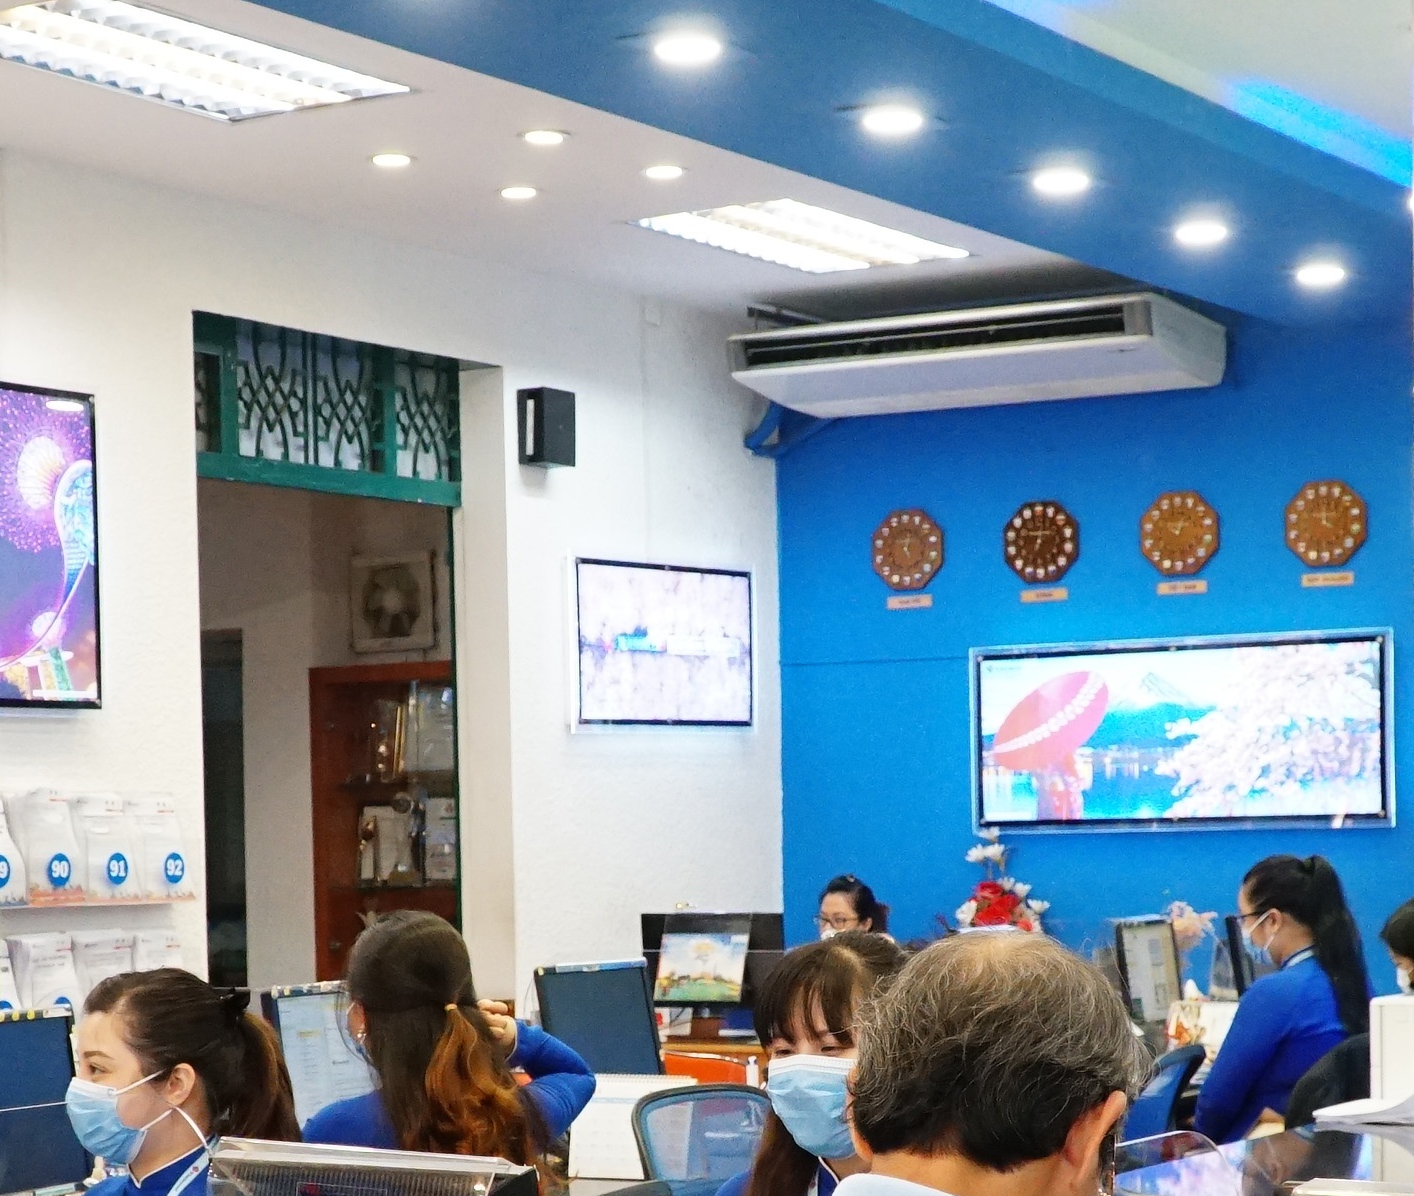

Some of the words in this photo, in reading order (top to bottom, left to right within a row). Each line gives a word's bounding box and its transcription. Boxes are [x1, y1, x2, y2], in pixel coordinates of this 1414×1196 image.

[51, 859, 68, 878] 90
[109, 858, 126, 877] 91
[166, 858, 183, 877] 92
